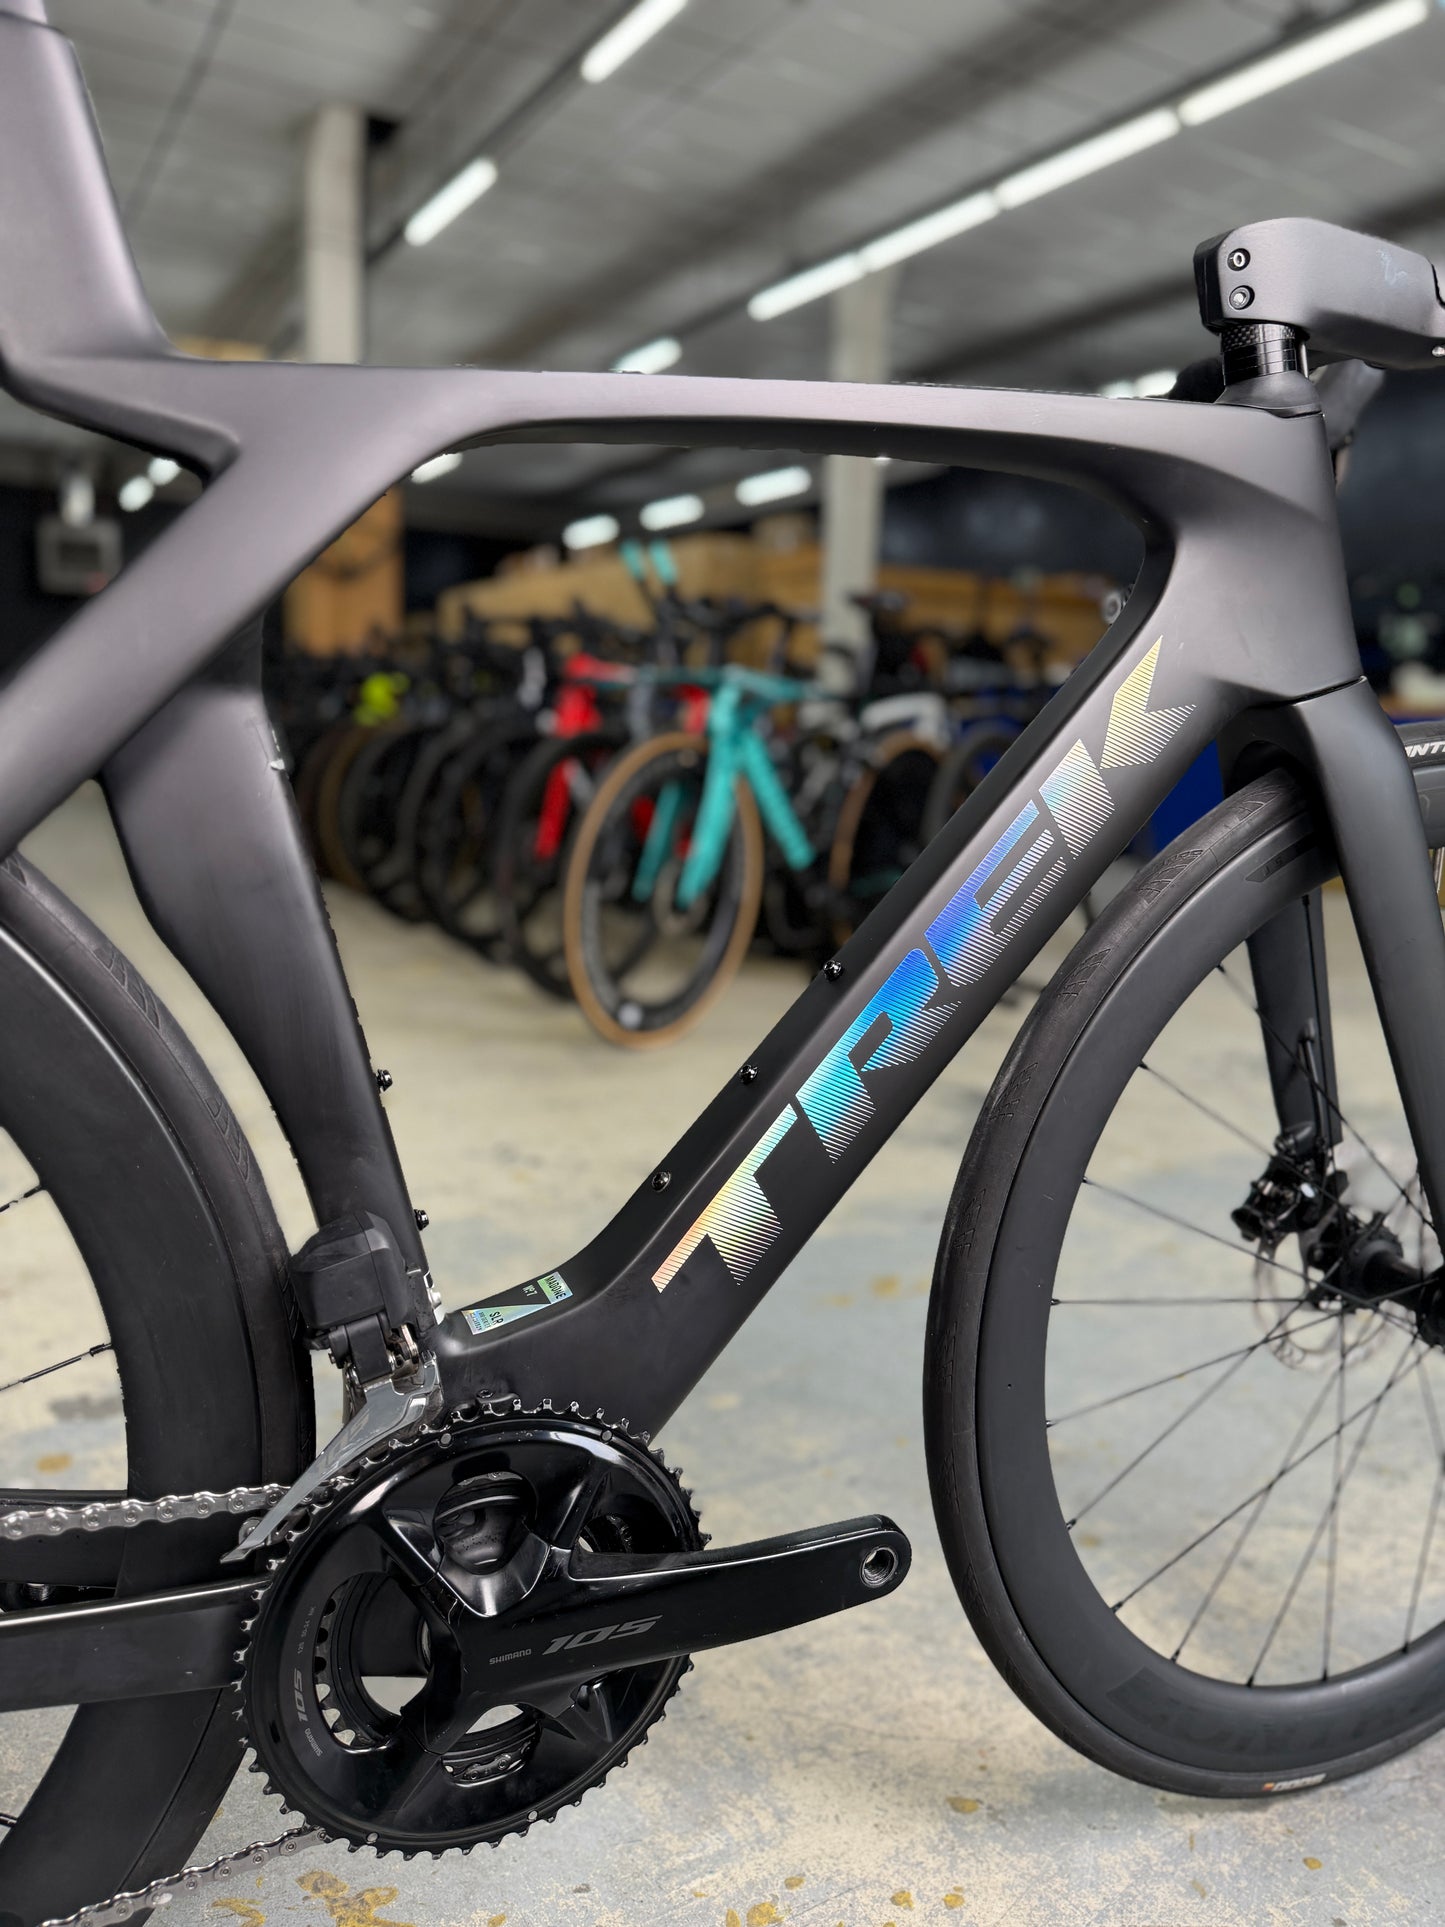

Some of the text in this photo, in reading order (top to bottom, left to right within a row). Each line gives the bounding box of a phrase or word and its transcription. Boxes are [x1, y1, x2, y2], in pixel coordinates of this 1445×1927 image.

[651, 635, 1197, 1293] TREK
[545, 1275, 567, 1300] MADONE
[489, 1311, 504, 1326] SLR
[489, 1614, 663, 1665] SHIMANO 105
[294, 1667, 309, 1722] 105
